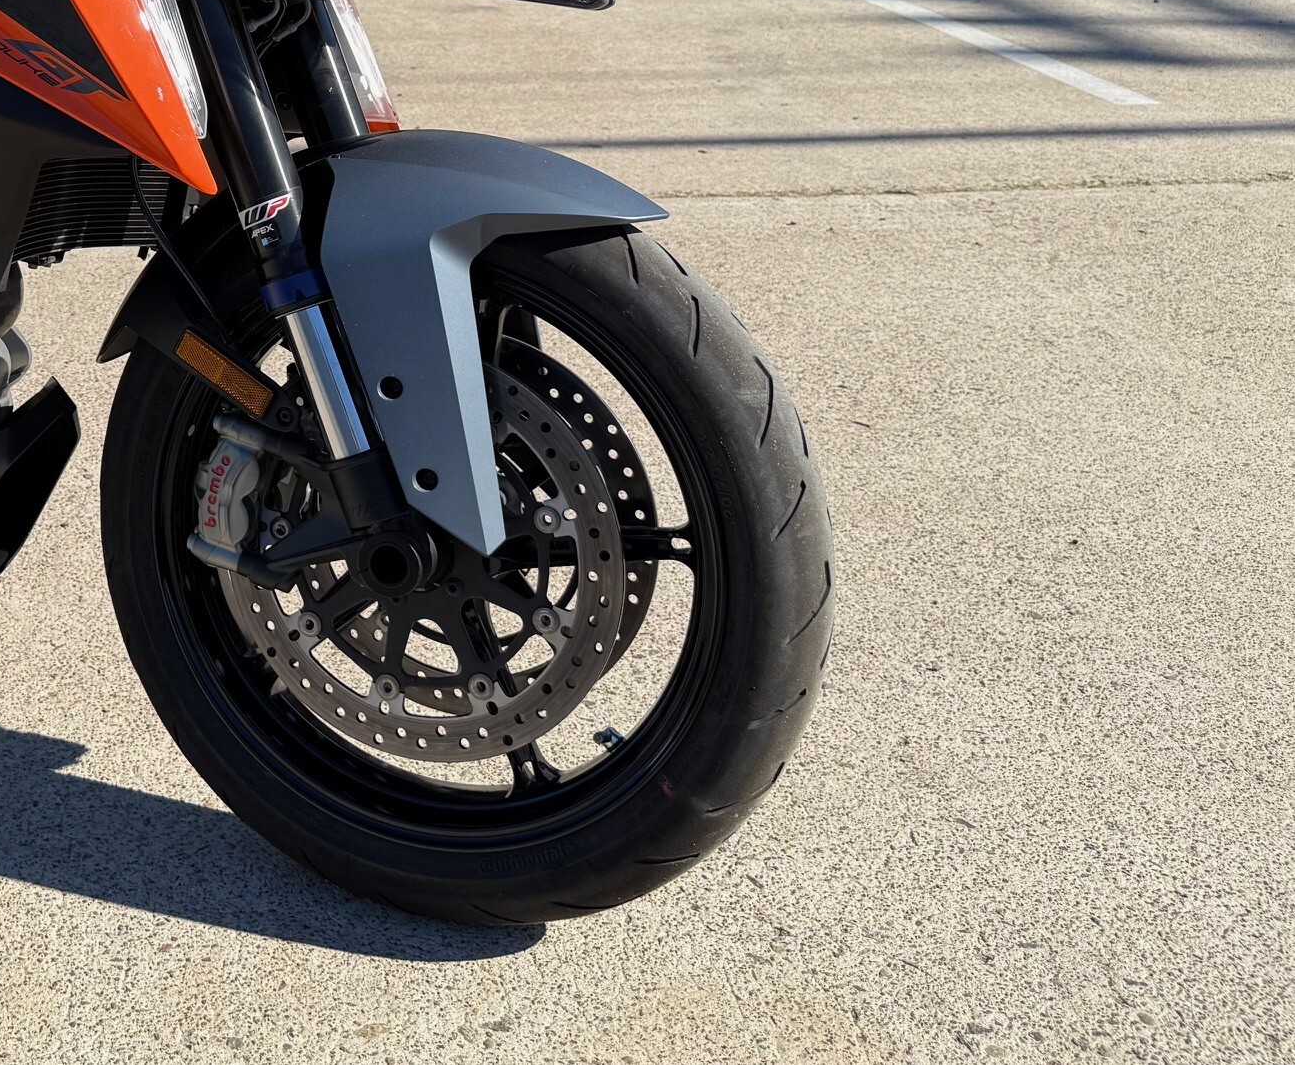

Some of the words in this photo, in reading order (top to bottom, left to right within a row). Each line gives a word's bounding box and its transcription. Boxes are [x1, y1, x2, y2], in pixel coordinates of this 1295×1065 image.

[3, 38, 124, 102] GT
[242, 194, 291, 229] WP
[251, 223, 274, 239] APEX
[204, 454, 231, 528] brembo
